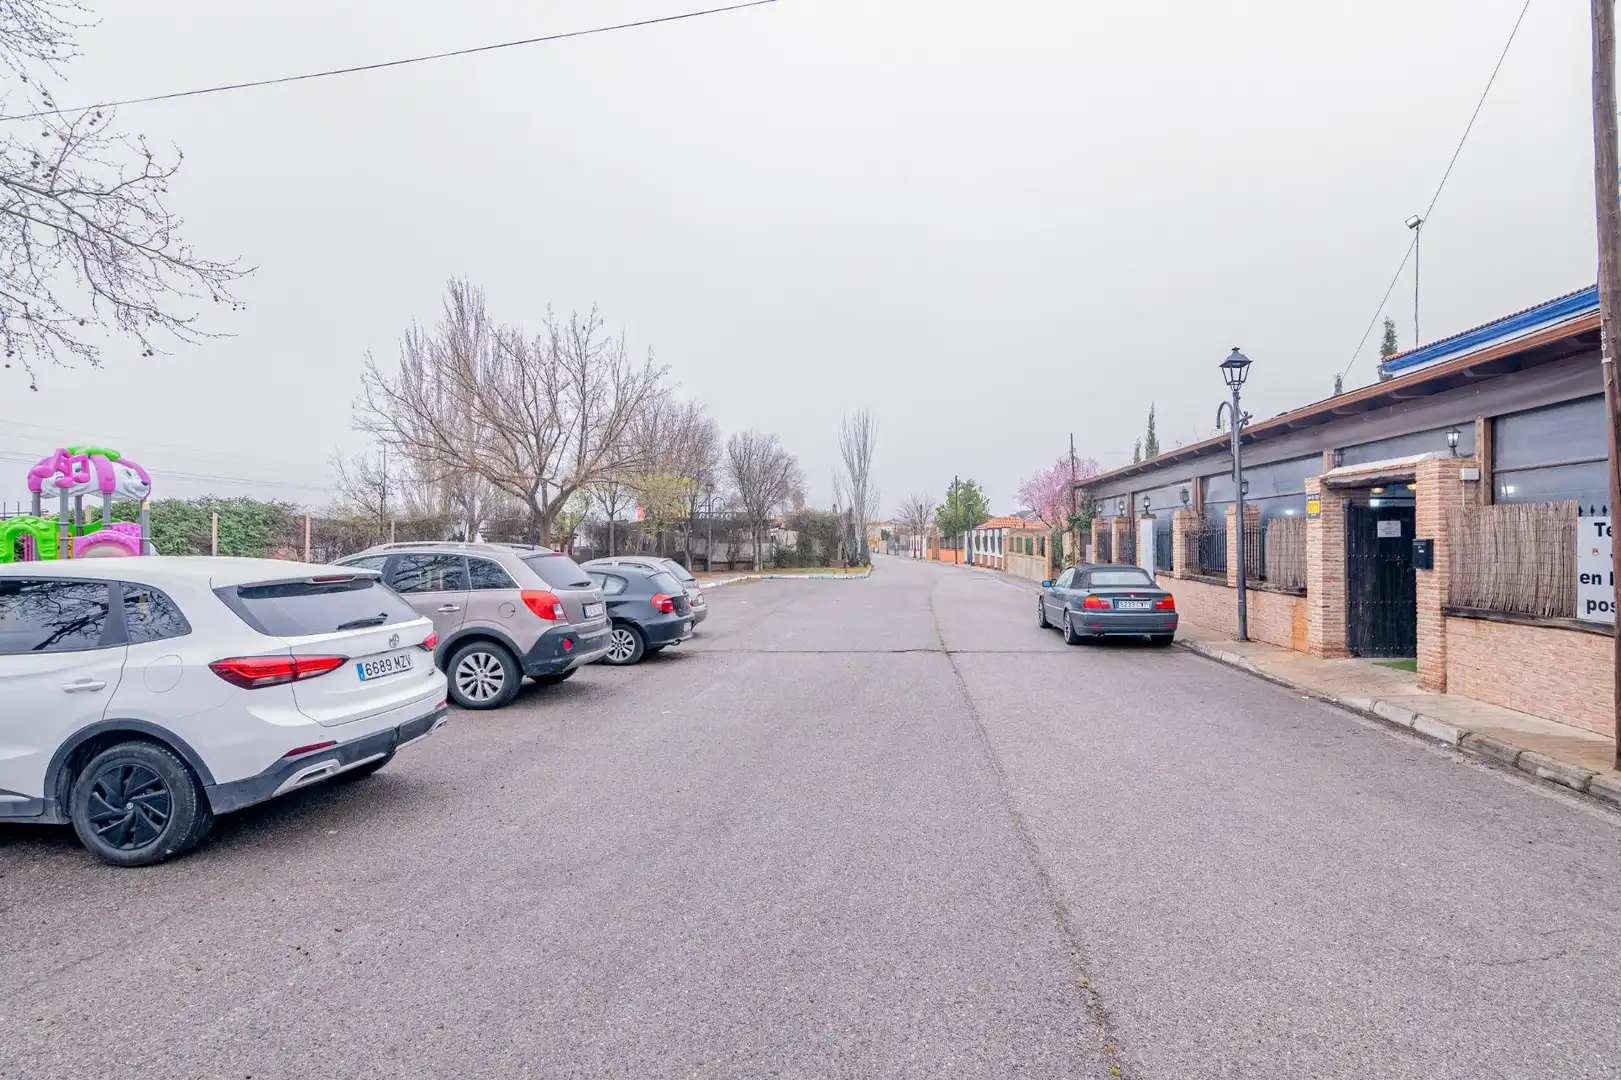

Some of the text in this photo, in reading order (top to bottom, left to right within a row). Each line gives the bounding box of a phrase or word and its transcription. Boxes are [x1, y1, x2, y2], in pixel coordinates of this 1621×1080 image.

[1580, 573, 1602, 585] en
[365, 654, 412, 677] 6689 MZV
